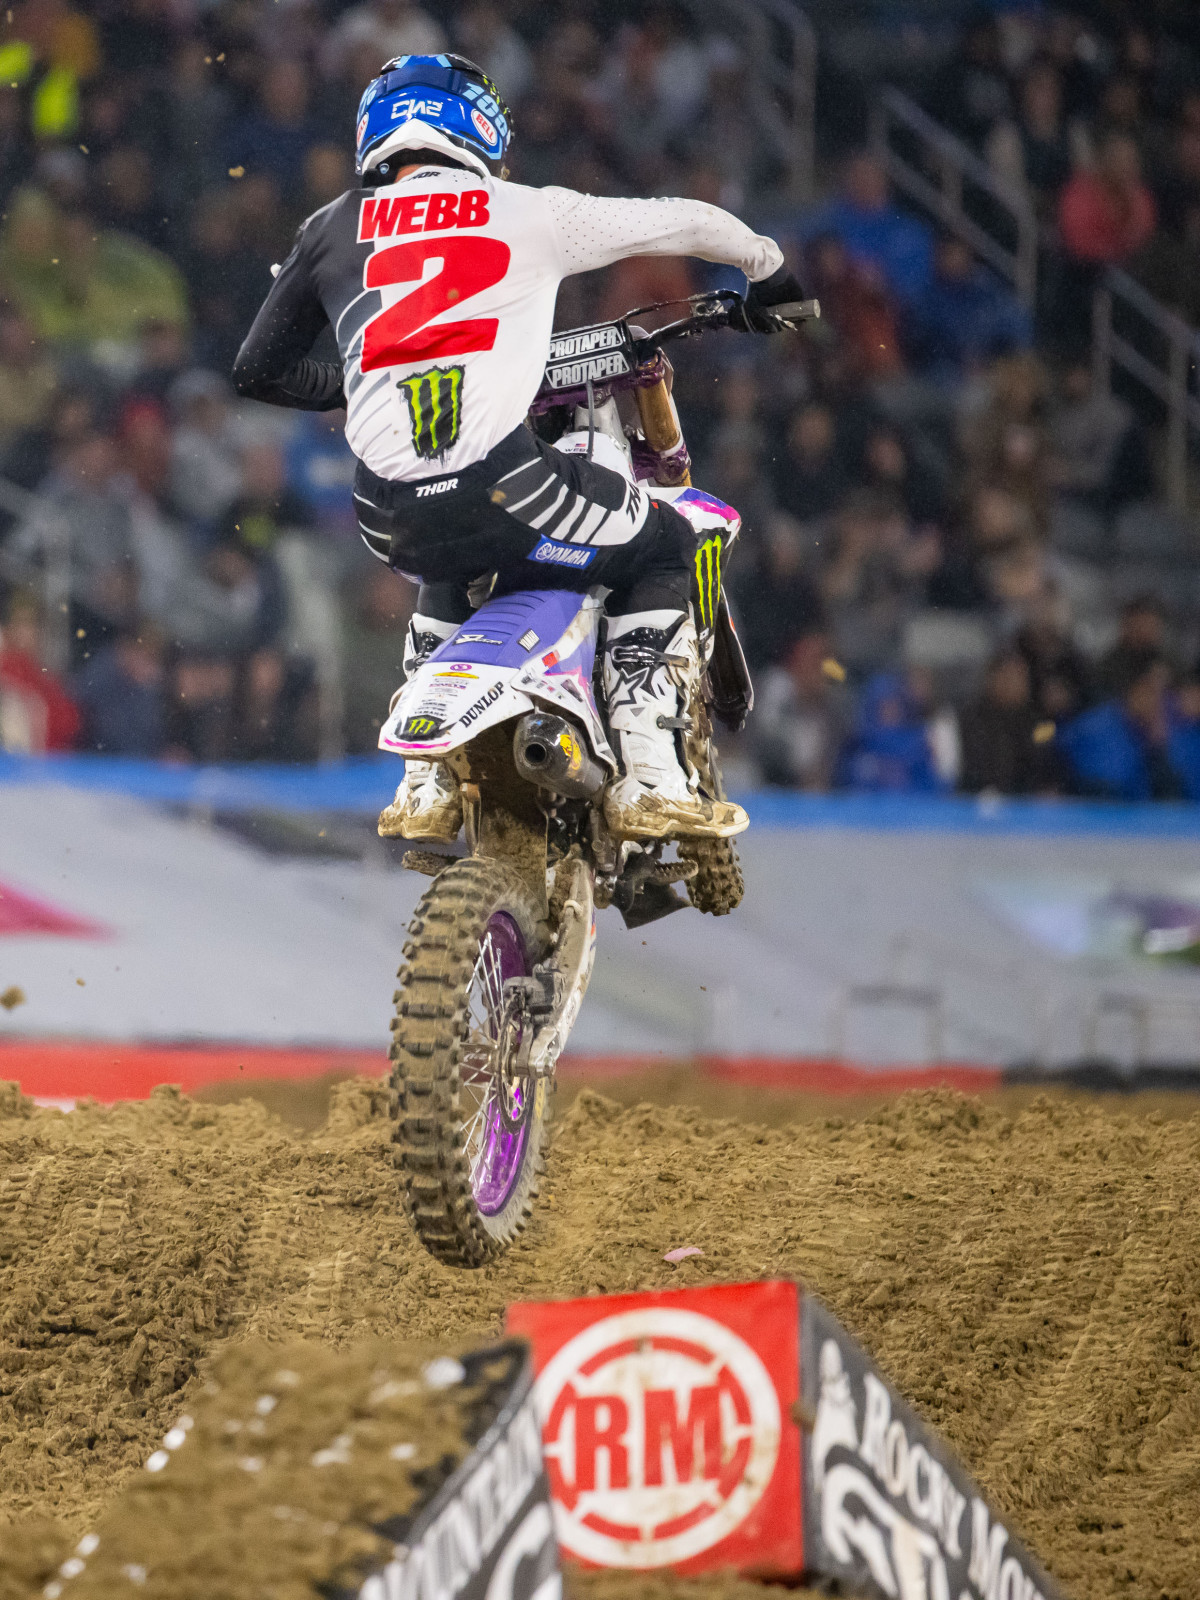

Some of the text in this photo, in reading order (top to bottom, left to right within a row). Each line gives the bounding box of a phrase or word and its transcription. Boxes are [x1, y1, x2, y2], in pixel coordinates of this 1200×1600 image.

[475, 113, 495, 141] BELL
[359, 189, 491, 241] WEBB
[360, 235, 512, 374] 2
[550, 327, 618, 358] PROTAPER
[552, 354, 623, 387] PROTAPER
[415, 477, 459, 498] THOR
[549, 544, 591, 566] YAMAHA
[458, 681, 505, 728] DUNLOP
[574, 1386, 727, 1491] RM
[859, 1372, 967, 1560] ROCKY
